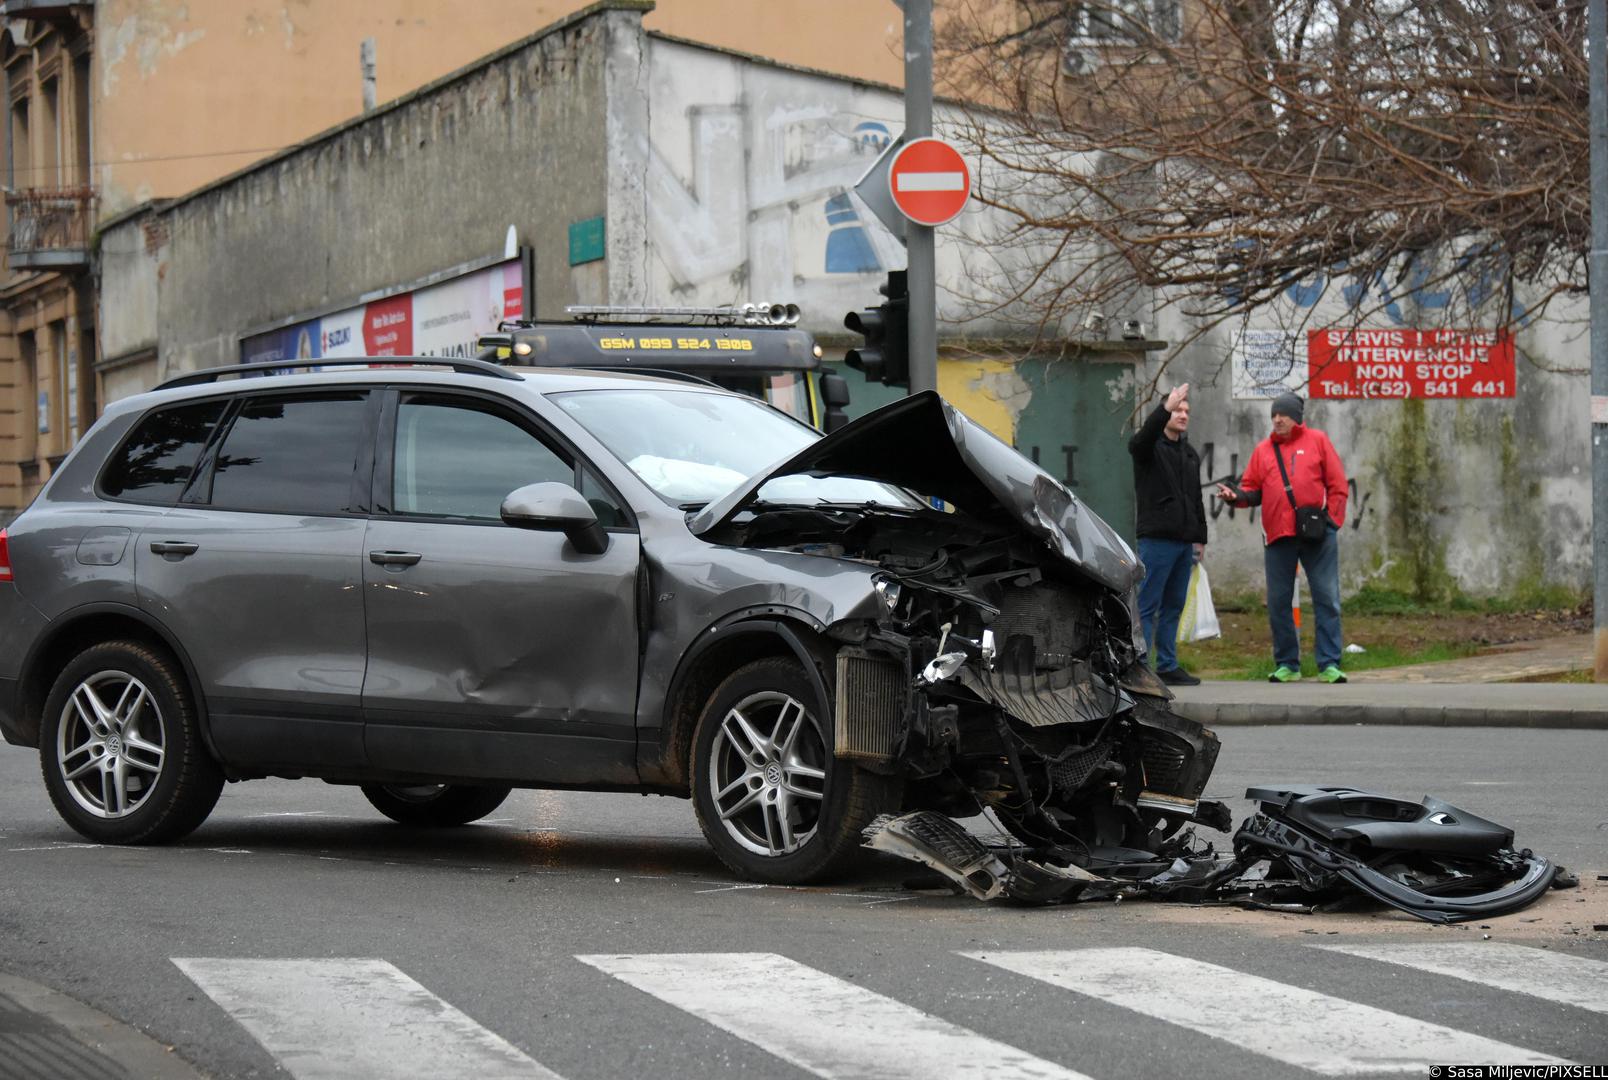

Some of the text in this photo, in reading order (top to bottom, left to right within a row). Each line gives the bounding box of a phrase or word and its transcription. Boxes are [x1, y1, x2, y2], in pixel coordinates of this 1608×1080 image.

[328, 326, 351, 349] SUZUKI
[600, 338, 753, 350] GSM 099 524 1308
[1328, 331, 1404, 346] SERVIS
[1435, 331, 1497, 346] HITNE
[1337, 347, 1488, 362] INTERVENCIJE
[1356, 364, 1473, 379] NON STOP
[1424, 381, 1458, 396] 541
[1472, 381, 1505, 396] 441
